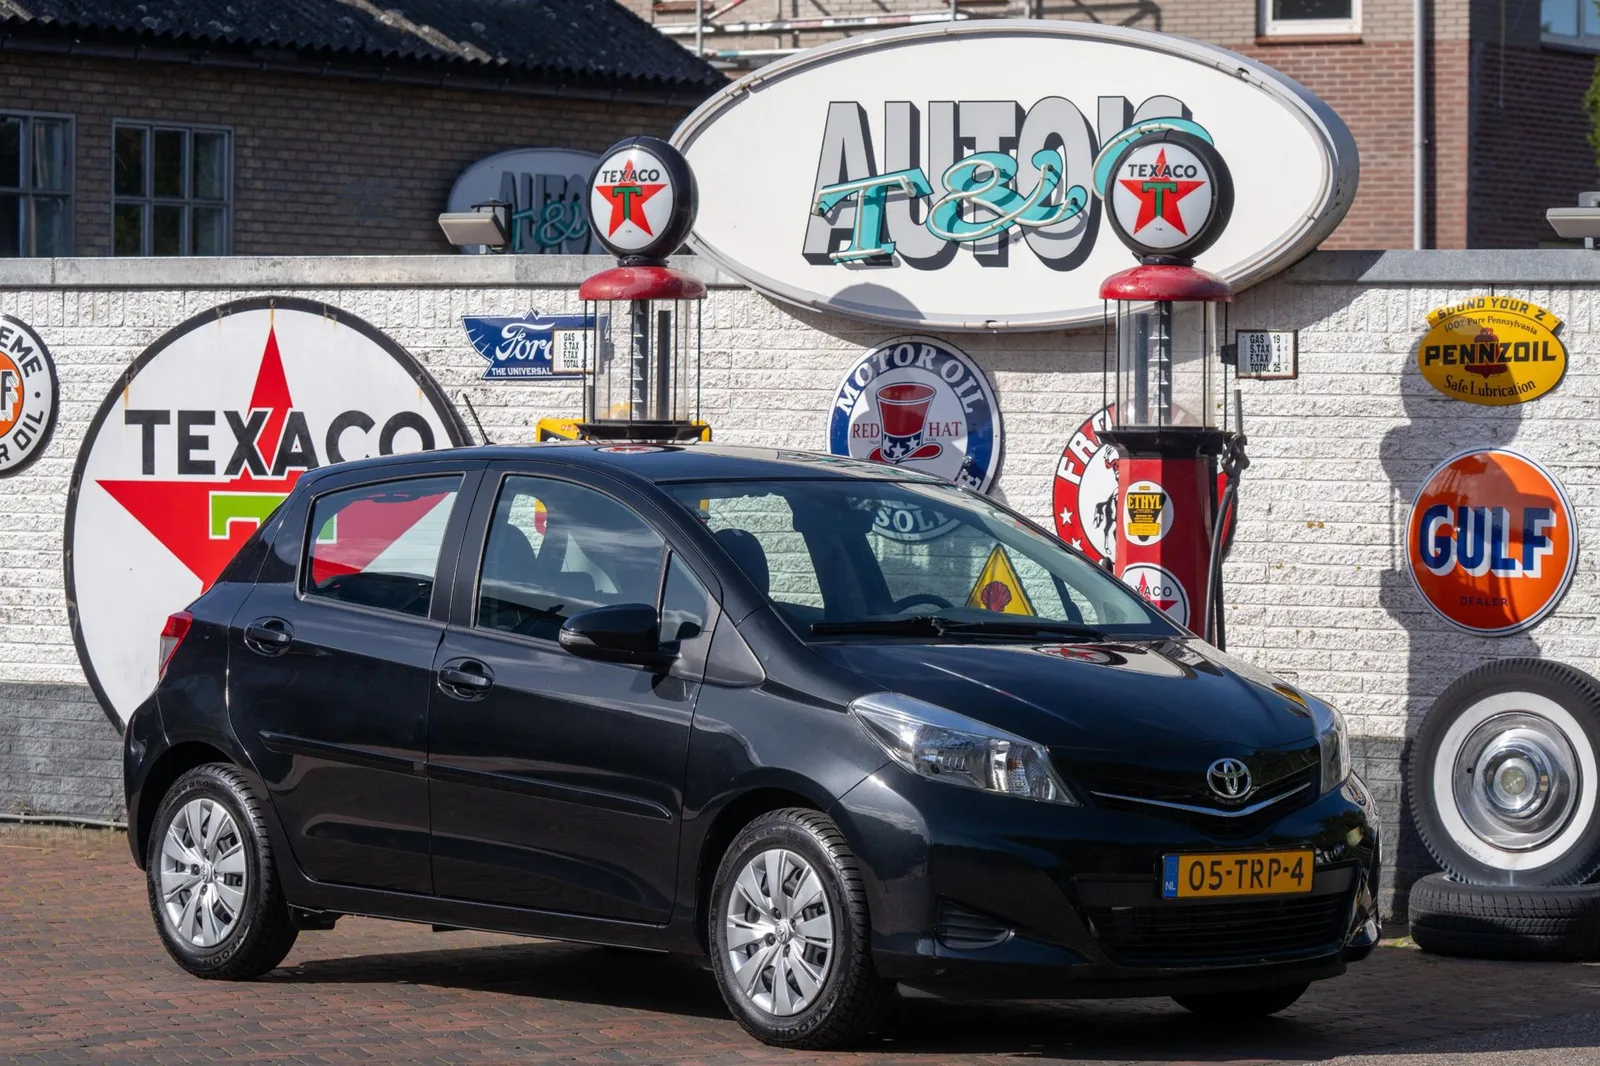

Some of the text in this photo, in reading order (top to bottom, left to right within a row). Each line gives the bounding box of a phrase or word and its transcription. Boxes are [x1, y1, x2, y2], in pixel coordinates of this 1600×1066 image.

[602, 169, 660, 183] TEXACO
[1128, 164, 1198, 179] TEXACO
[1437, 299, 1548, 322] SOUND YOUR Z
[1467, 317, 1486, 327] Pure
[1487, 315, 1538, 336] Pennsylvania
[563, 332, 576, 342] GAS
[1249, 334, 1265, 344] GAS
[563, 342, 580, 351] S.TAX
[1249, 344, 1270, 354] S.TAX
[1425, 341, 1557, 366] PENNZOIL
[563, 360, 580, 368] TOTAL
[1249, 354, 1270, 363] F.TAX
[491, 367, 552, 376] THE UNIVERSAL
[1249, 363, 1271, 373] TOTAL
[836, 343, 985, 416] MOTOR OIL
[1444, 374, 1536, 397] Safe Lubrication
[13, 410, 45, 451] OIL
[852, 421, 962, 439] RED HAT
[125, 408, 436, 477] TEXACO
[1126, 494, 1163, 509] ETHYL
[1419, 504, 1557, 579] GULF
[1134, 586, 1172, 598] XACO
[1460, 596, 1509, 607] DEALER
[1188, 856, 1305, 891] 05-TRP-4
[1164, 881, 1177, 892] NL
